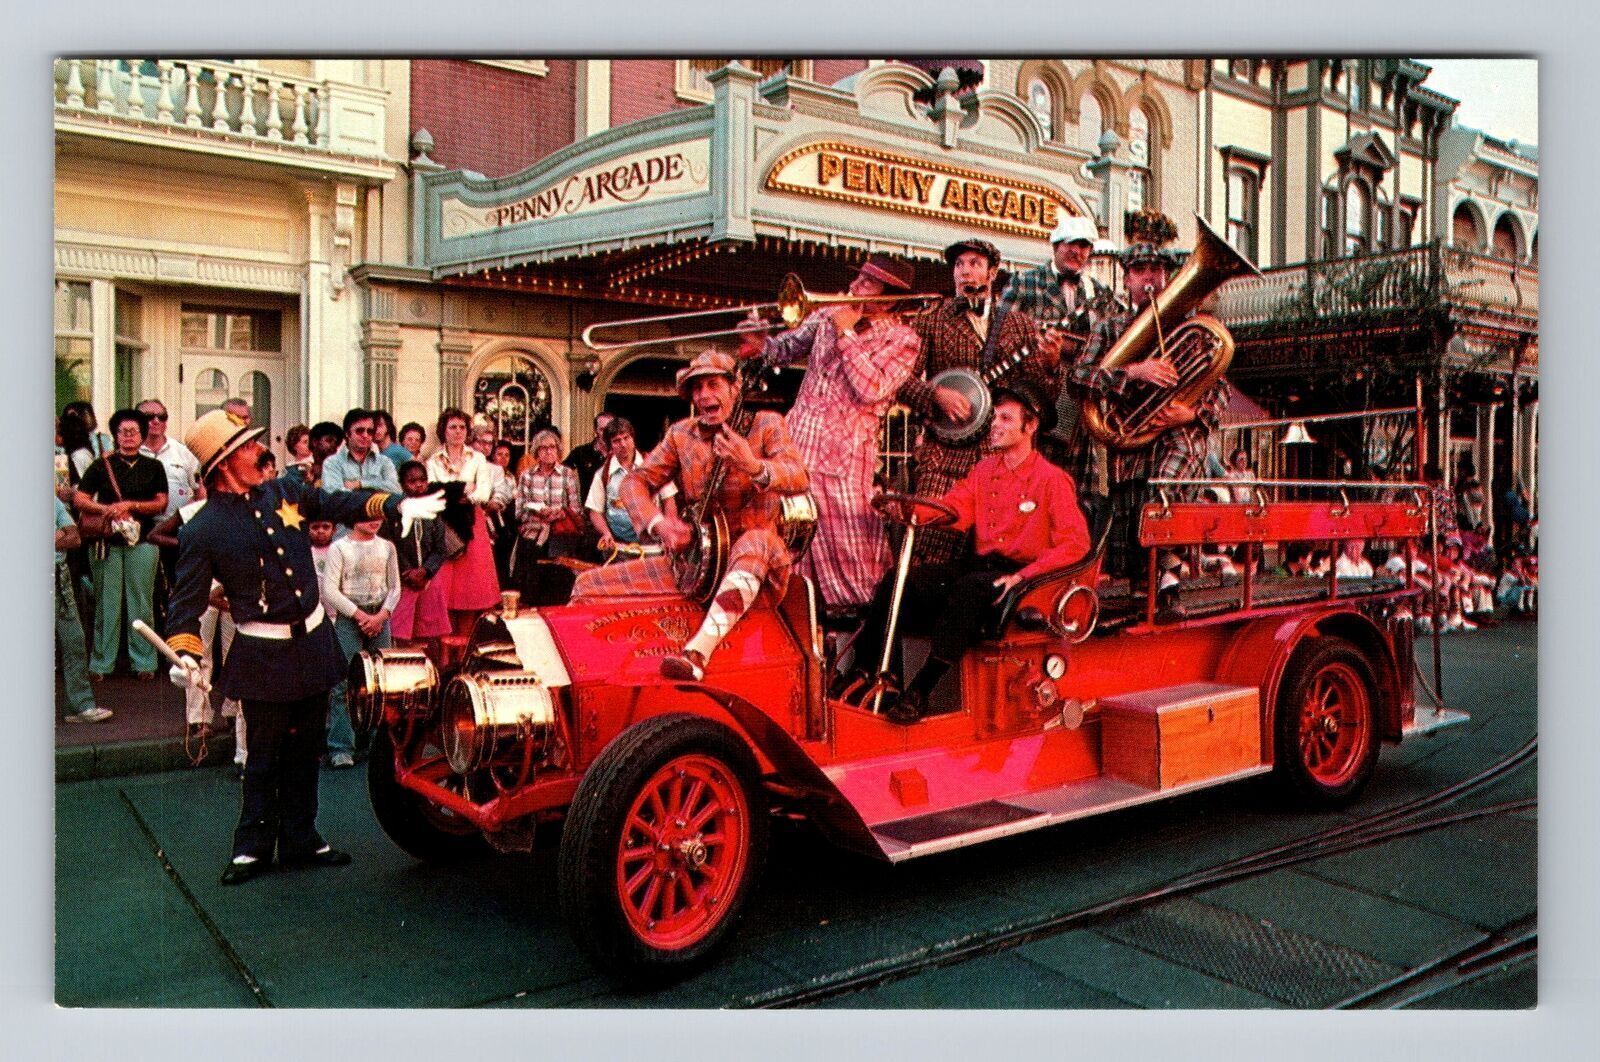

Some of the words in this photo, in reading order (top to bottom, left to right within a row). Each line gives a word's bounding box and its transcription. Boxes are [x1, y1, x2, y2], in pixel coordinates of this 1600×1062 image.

[496, 176, 579, 226] PENNY
[563, 153, 685, 214] ARCADE
[816, 151, 936, 205] PENNY
[940, 178, 1060, 229] ARCADE
